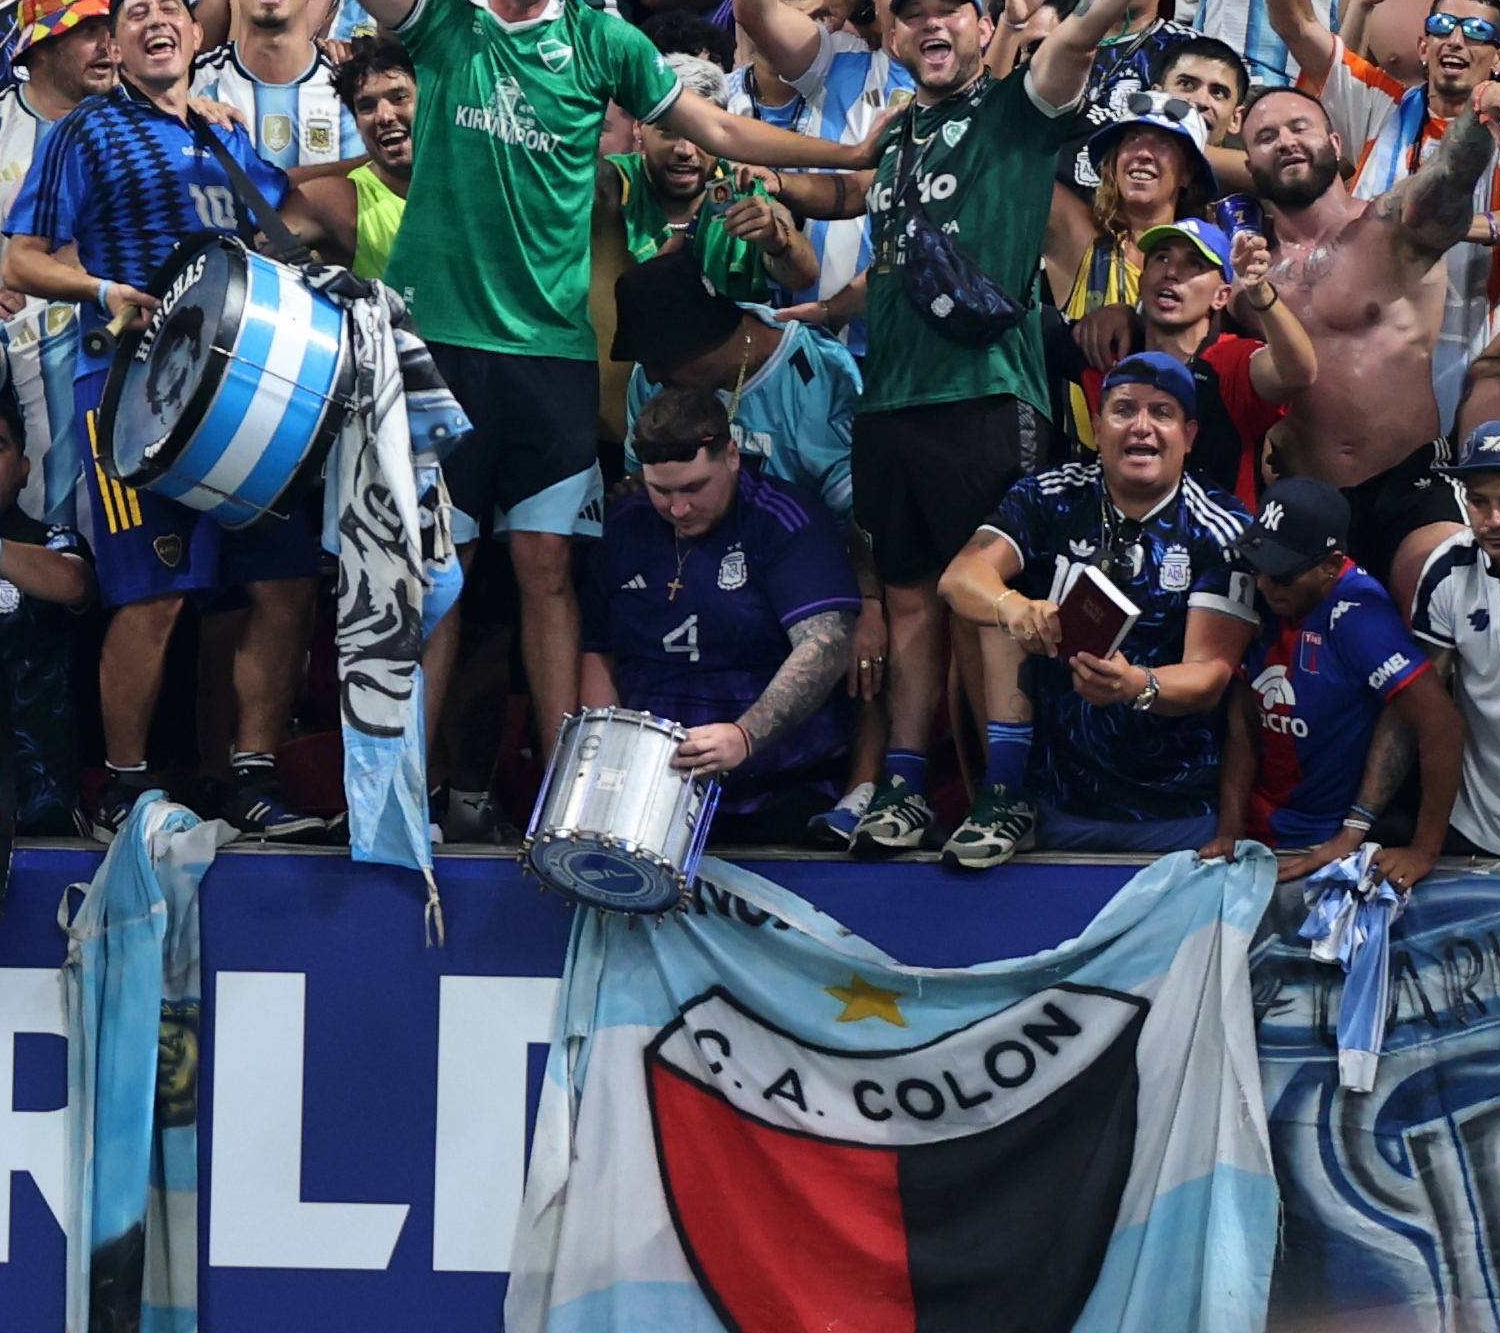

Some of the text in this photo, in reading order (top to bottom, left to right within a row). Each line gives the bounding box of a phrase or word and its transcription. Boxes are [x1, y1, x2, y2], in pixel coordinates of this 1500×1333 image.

[187, 183, 239, 230] 10
[661, 613, 699, 664] 4
[852, 1002, 1083, 1122] COLON
